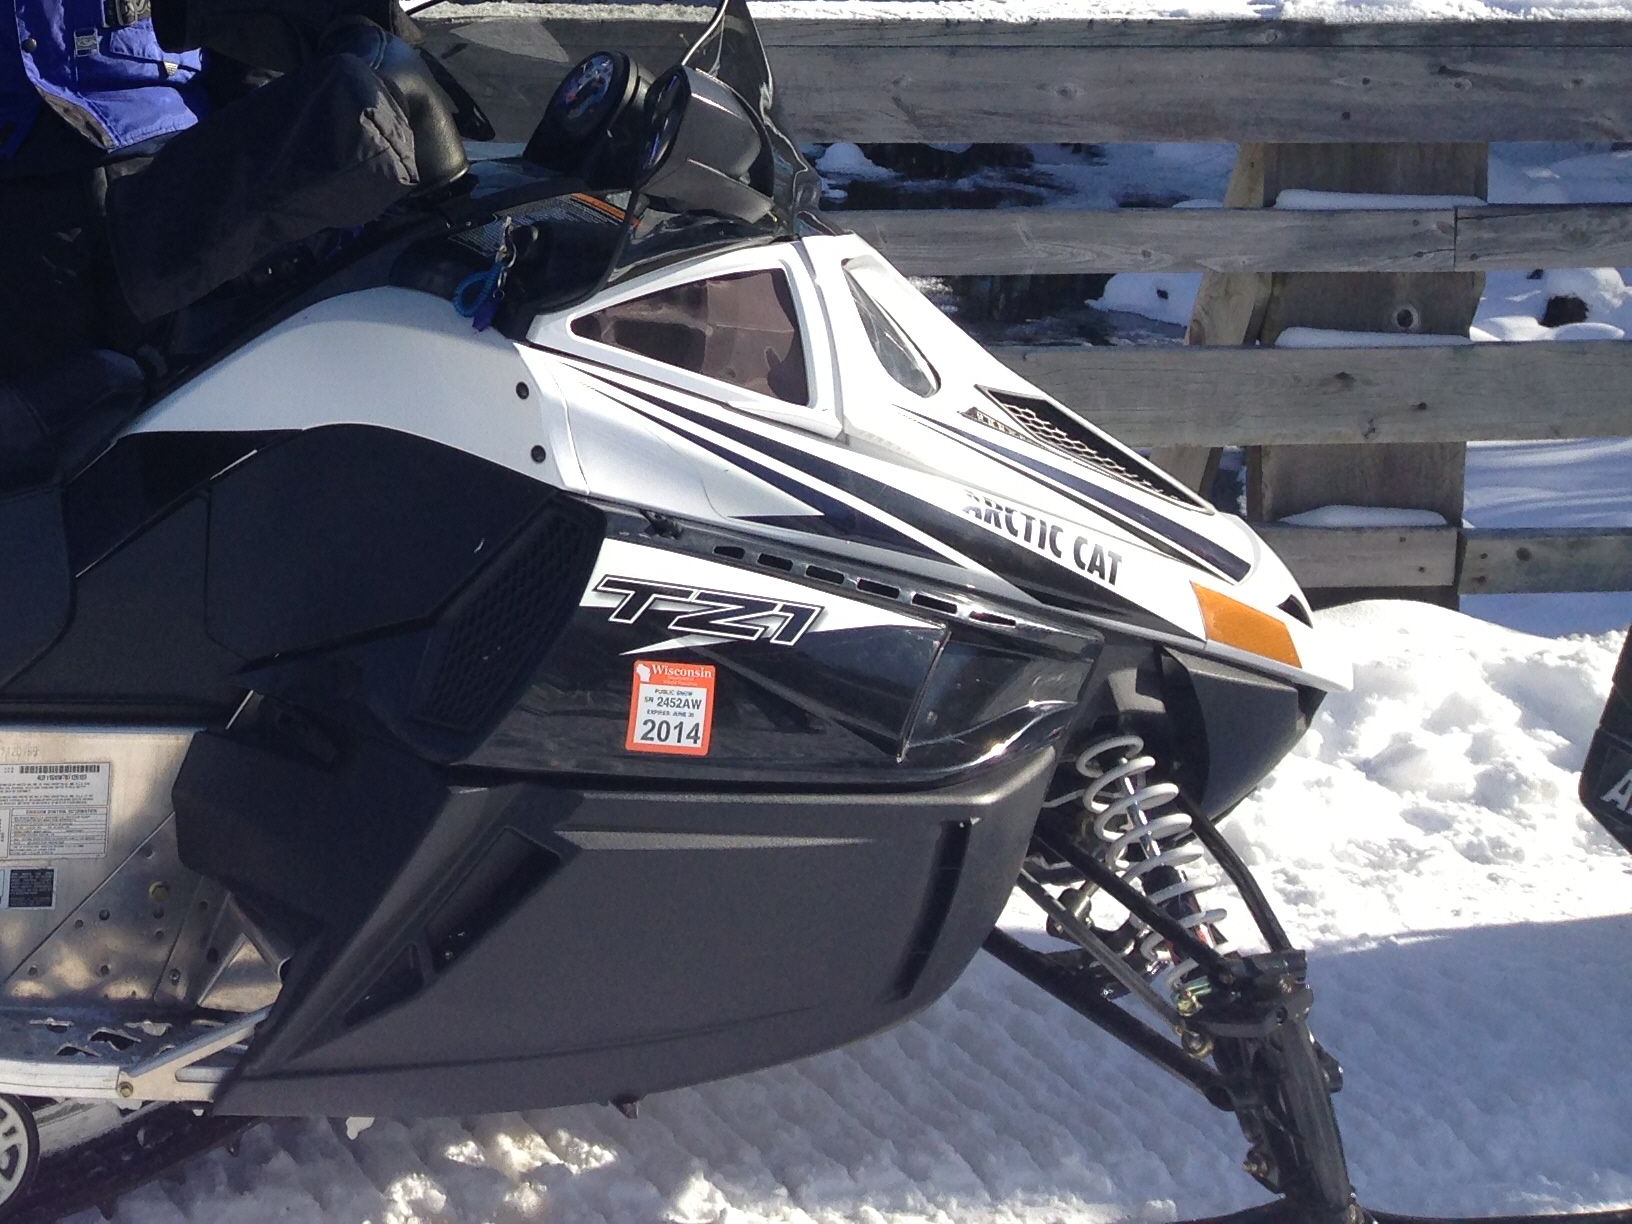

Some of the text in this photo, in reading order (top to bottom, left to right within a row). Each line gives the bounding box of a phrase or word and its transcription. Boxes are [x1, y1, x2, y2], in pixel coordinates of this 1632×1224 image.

[962, 490, 1123, 586] ARCTIC CAT
[592, 574, 825, 646] TZ1
[651, 664, 712, 678] Wisconsin
[657, 696, 702, 710] 2452AW
[640, 718, 701, 745] 2014
